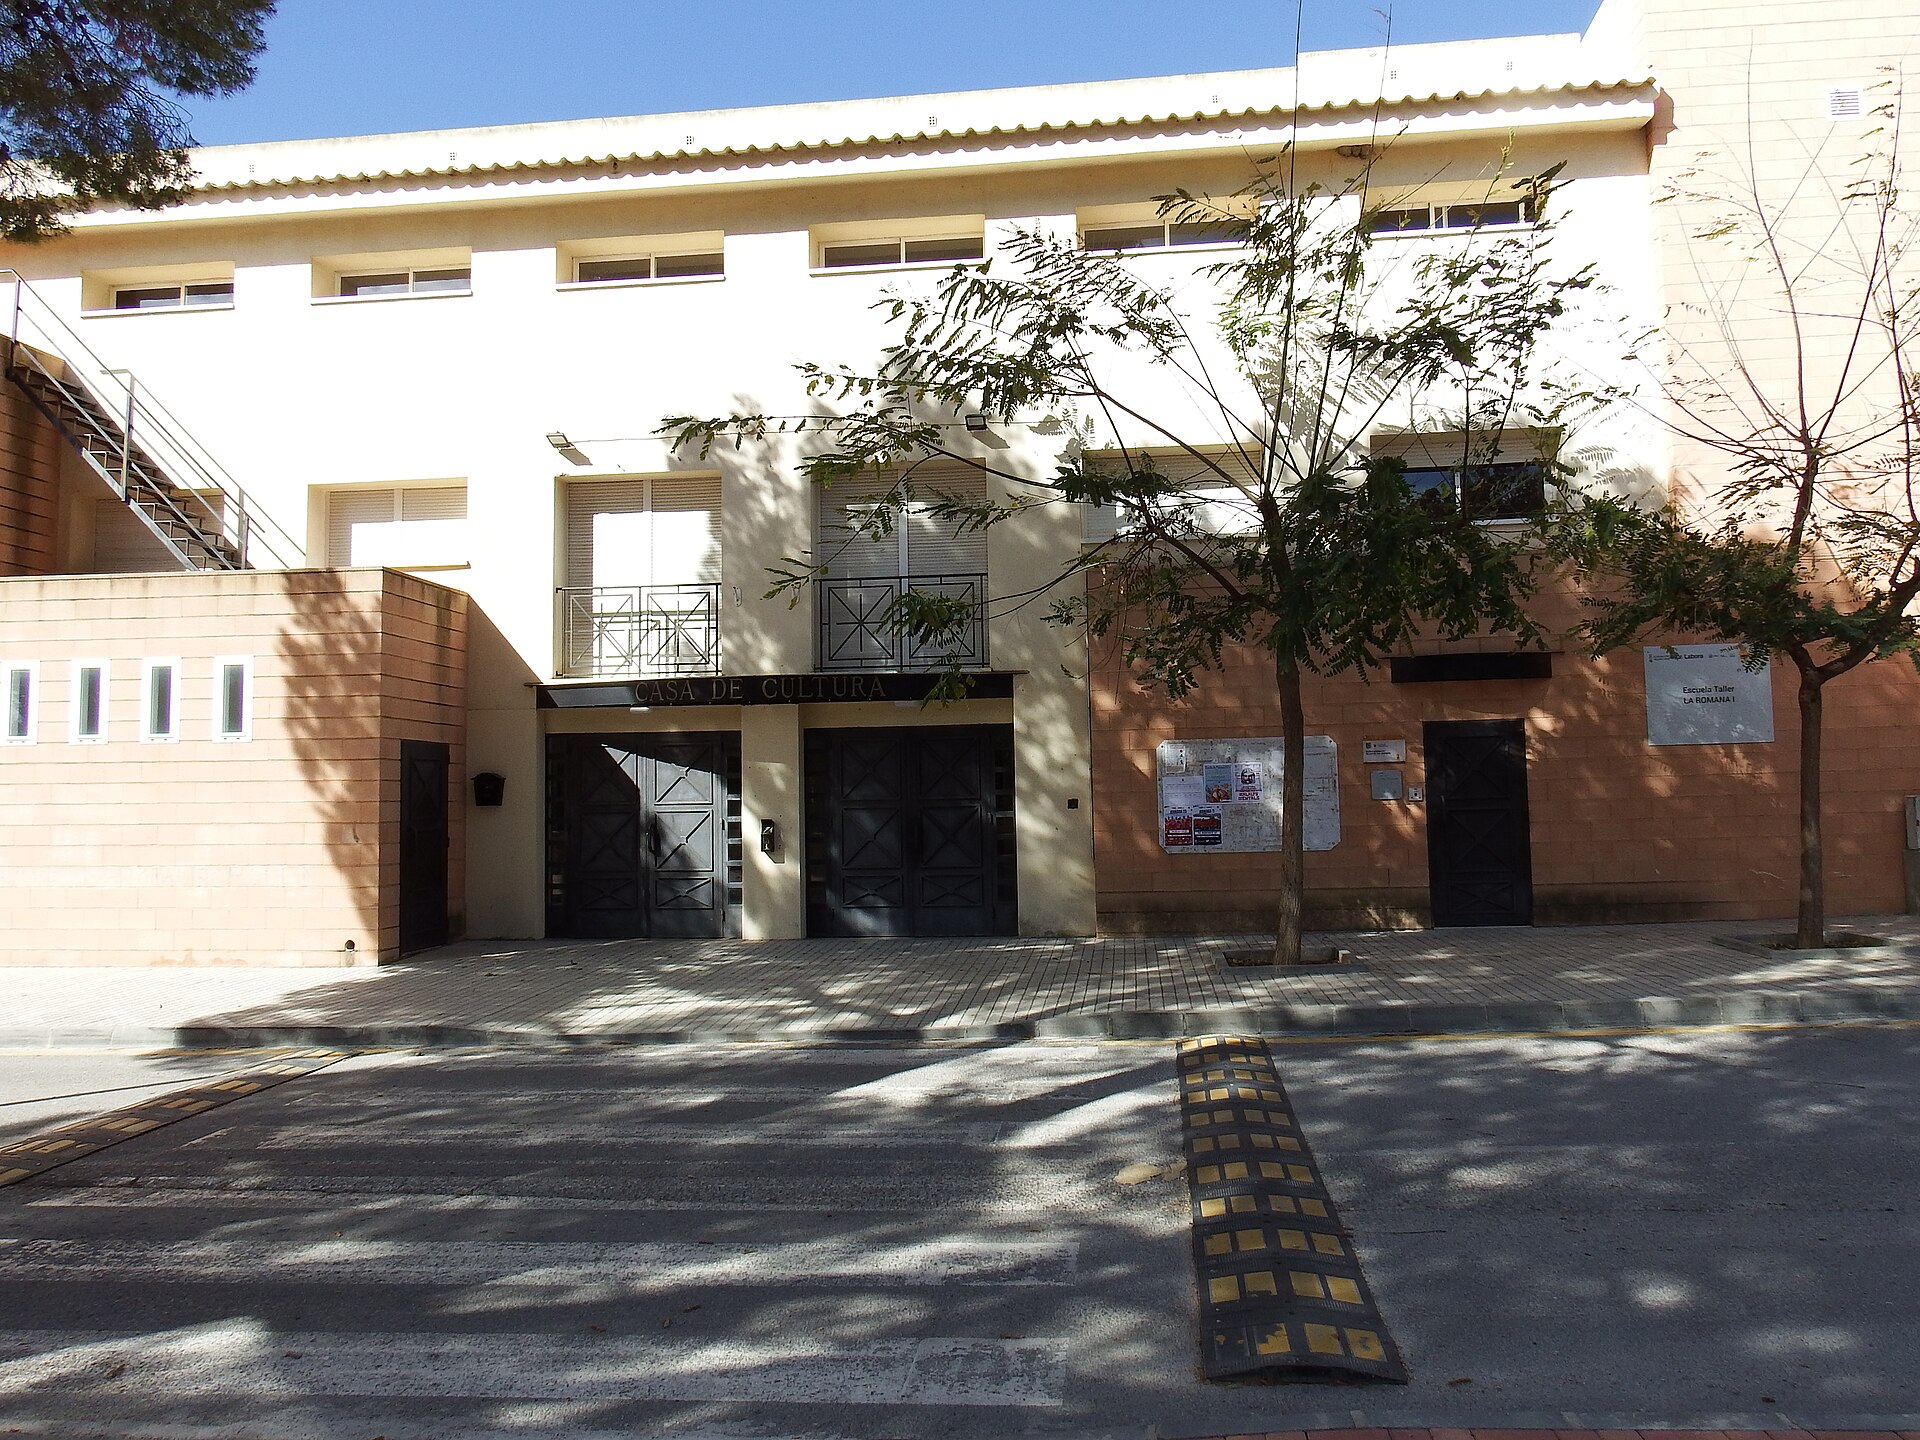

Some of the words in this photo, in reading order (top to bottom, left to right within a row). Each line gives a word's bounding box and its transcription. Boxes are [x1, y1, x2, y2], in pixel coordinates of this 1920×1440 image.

[634, 680, 696, 702] CASA
[711, 678, 744, 700] DE
[761, 676, 887, 699] CULTURA
[1682, 686, 1712, 694] Escuela
[1714, 685, 1735, 693] Taller
[1695, 696, 1731, 704] ROMANA
